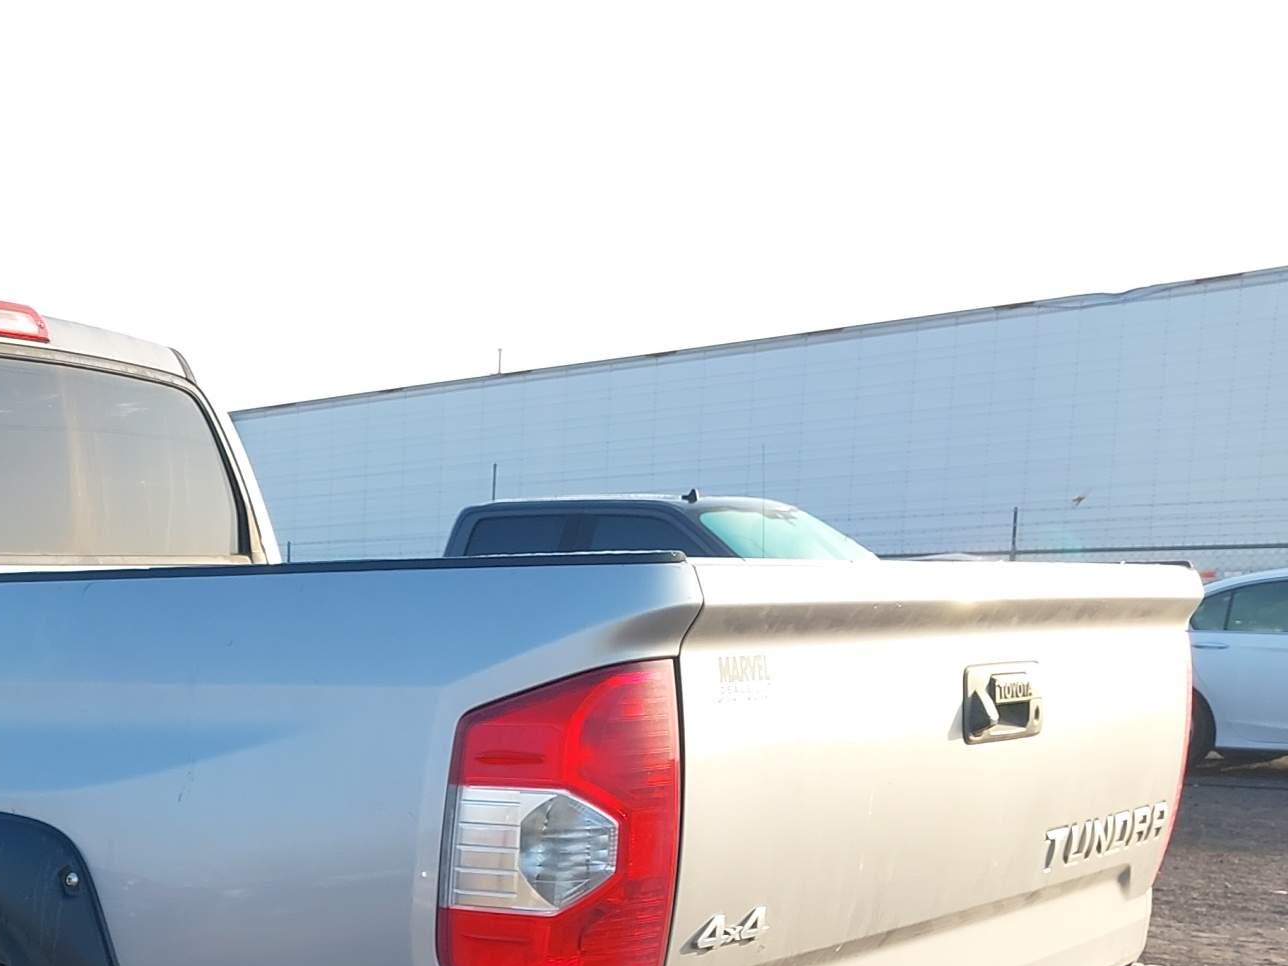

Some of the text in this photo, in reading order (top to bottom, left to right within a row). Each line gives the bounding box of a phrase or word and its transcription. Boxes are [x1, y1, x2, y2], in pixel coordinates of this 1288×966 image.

[718, 655, 771, 682] MARVEL
[1043, 800, 1168, 869] TUNDRA
[692, 906, 770, 952] 4x4
